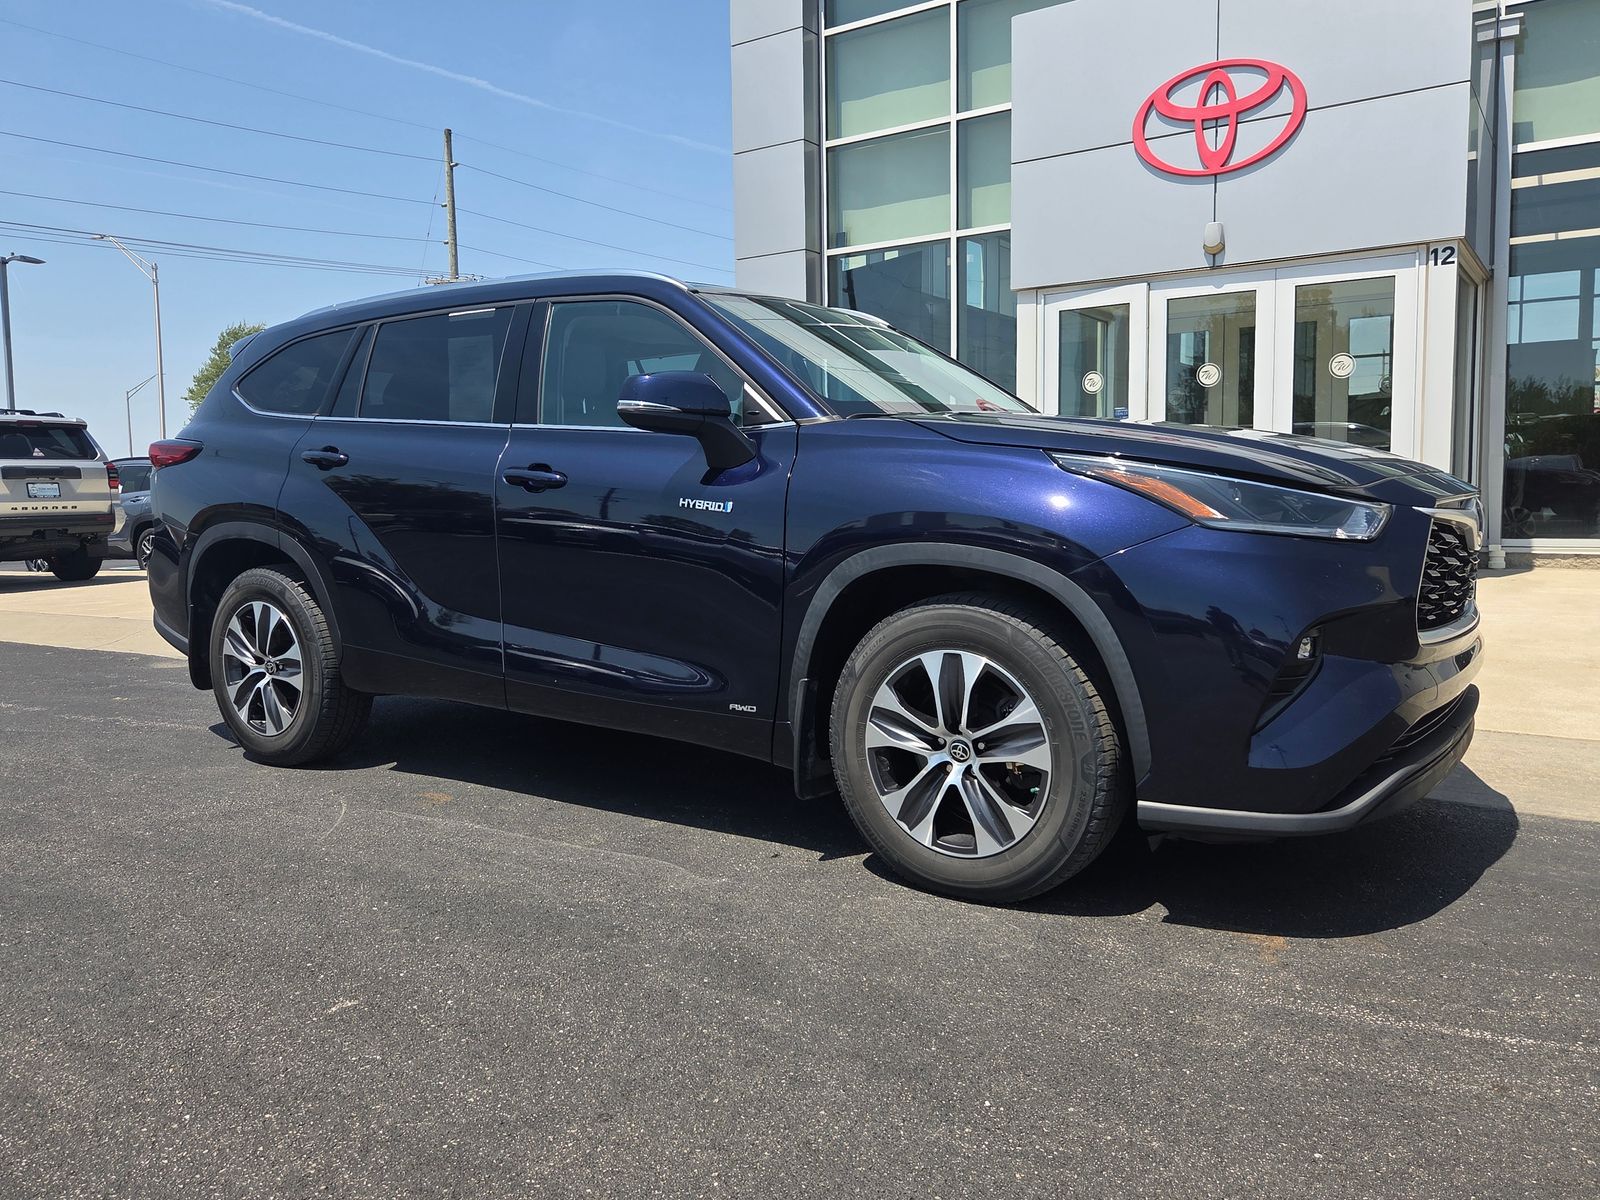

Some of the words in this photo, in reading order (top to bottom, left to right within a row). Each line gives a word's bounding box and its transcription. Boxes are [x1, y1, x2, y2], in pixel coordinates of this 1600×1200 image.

[1430, 245, 1456, 267] 12
[679, 497, 724, 512] HYBRID
[729, 703, 757, 713] AWD
